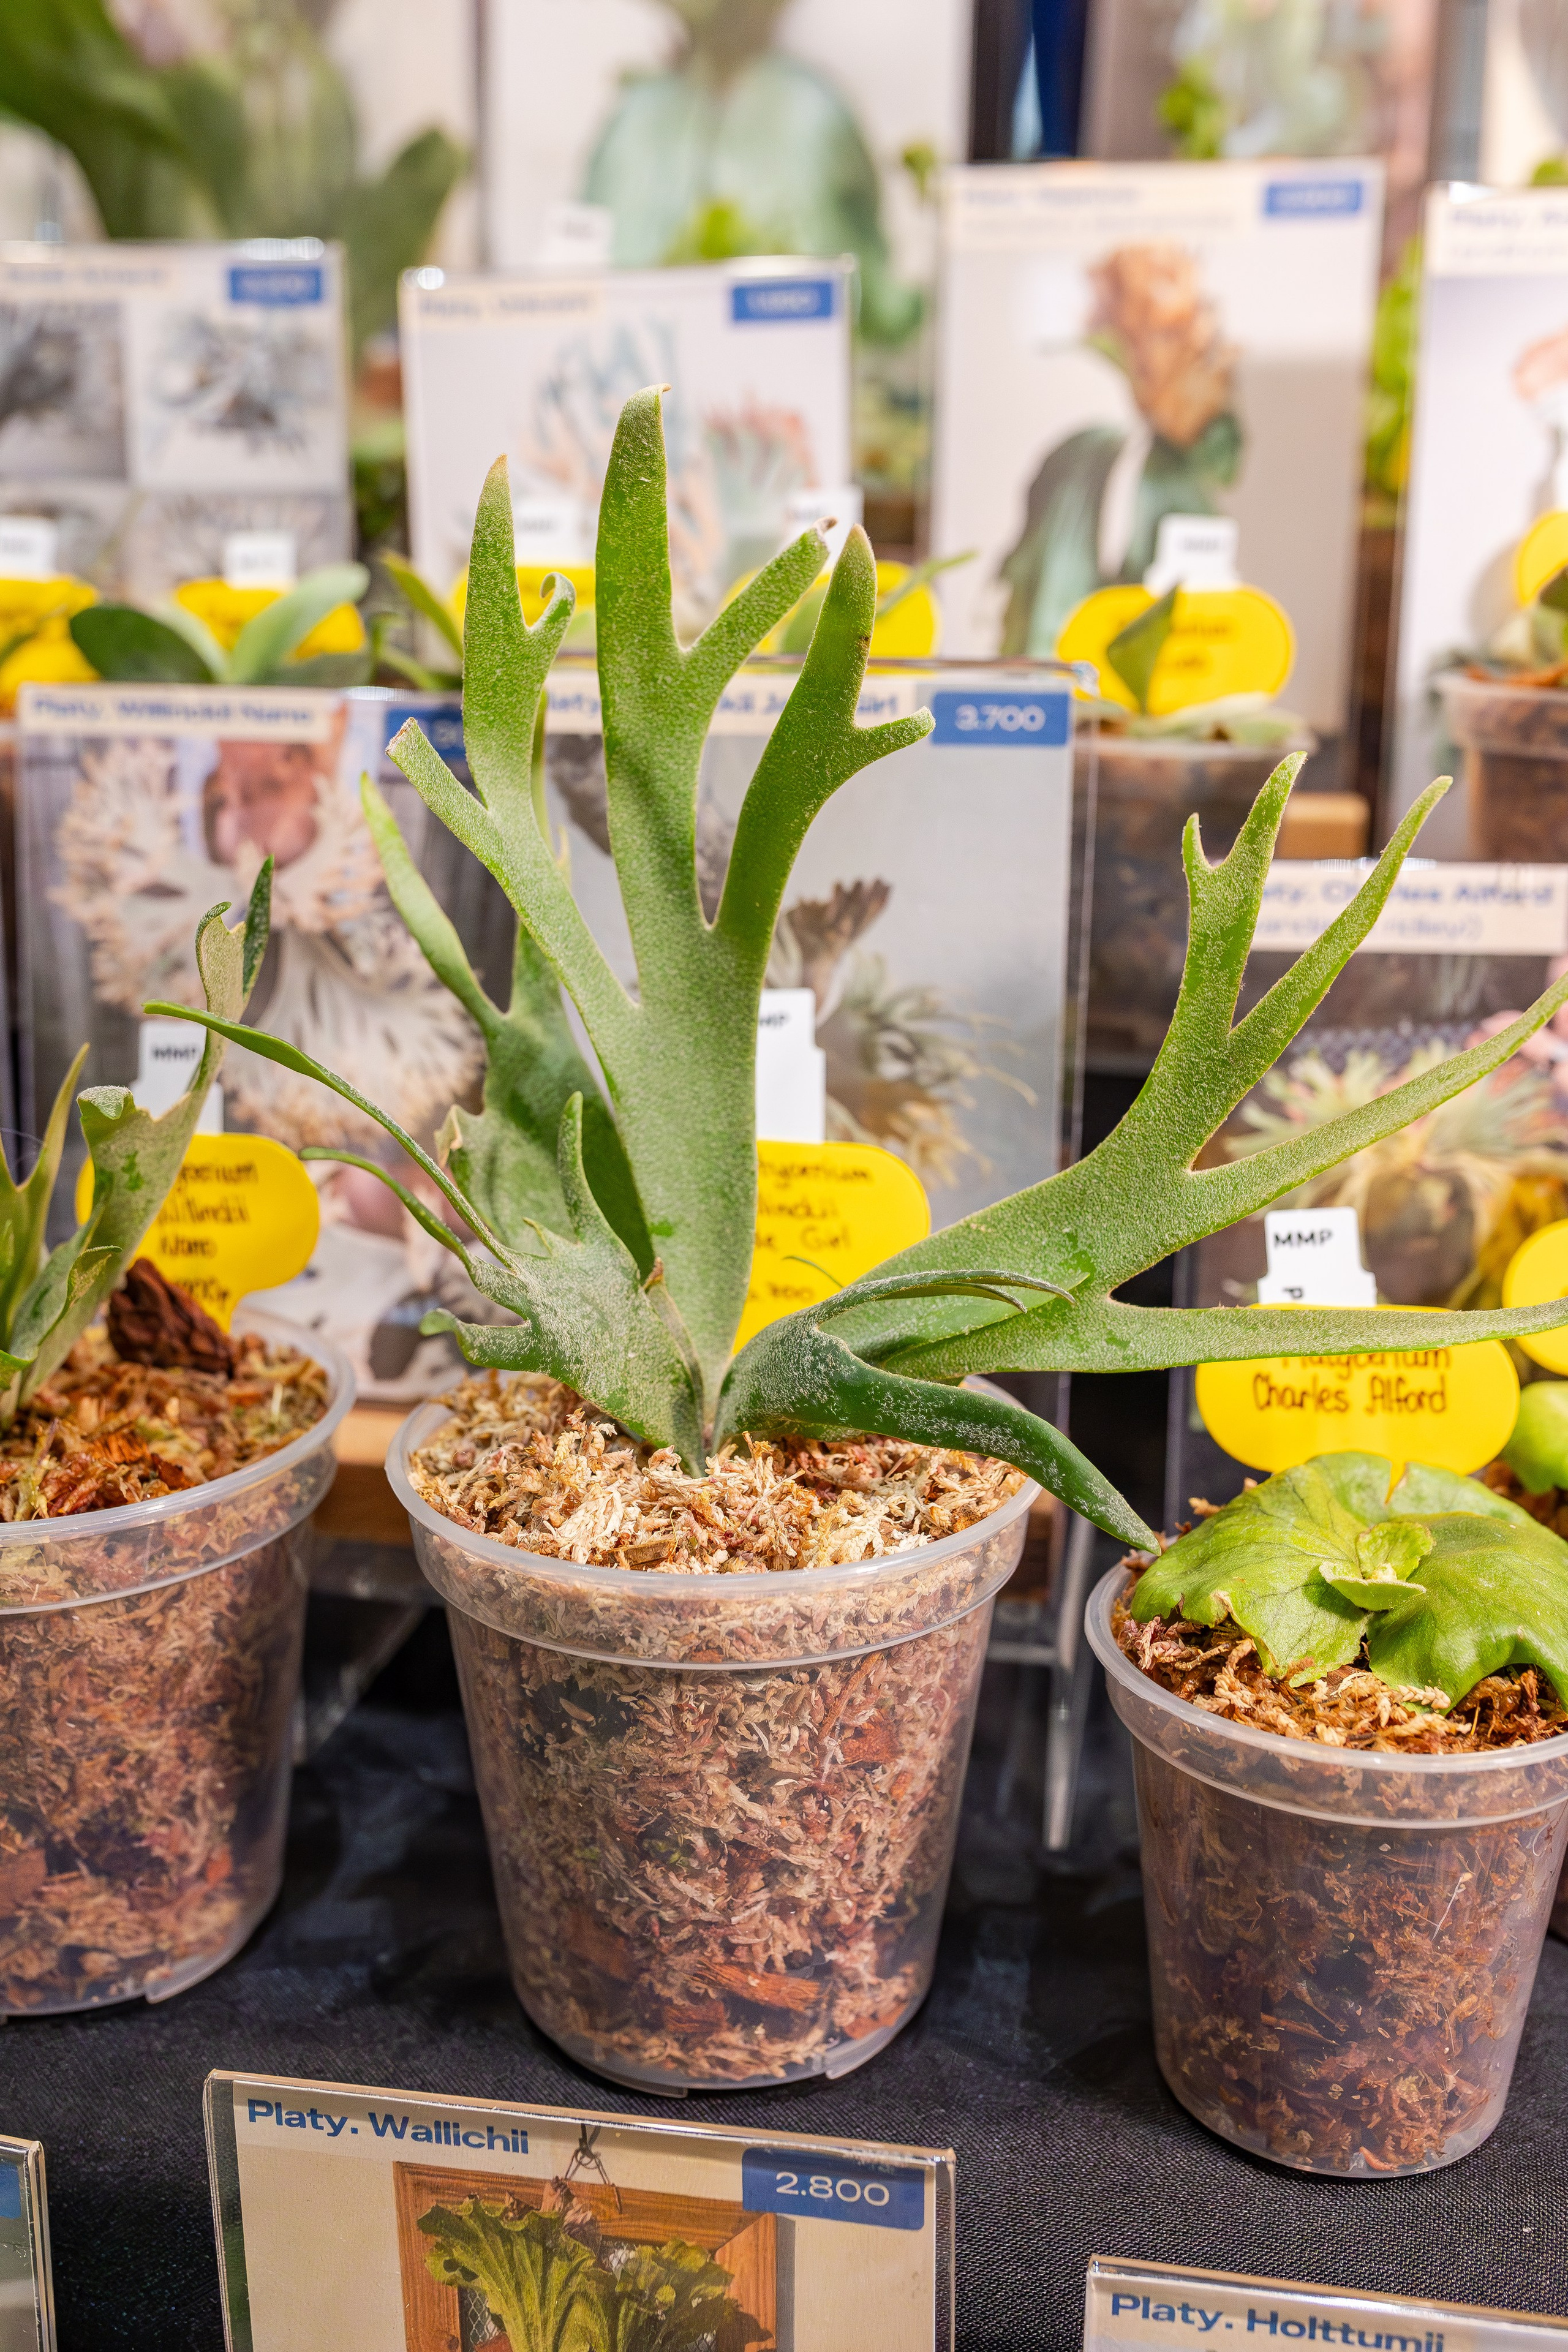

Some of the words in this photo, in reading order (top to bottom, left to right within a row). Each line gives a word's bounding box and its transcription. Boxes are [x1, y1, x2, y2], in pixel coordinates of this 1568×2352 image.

[1274, 1229, 1333, 1250] MMP
[1253, 1373, 1349, 1412] Charles
[1365, 1374, 1447, 1414] Alford
[247, 2098, 358, 2137] Platy.
[368, 2112, 529, 2154] Wallichii
[776, 2171, 889, 2206] 2.800
[1111, 2293, 1233, 2332] Platy.
[1247, 2309, 1444, 2352] Holttumii
